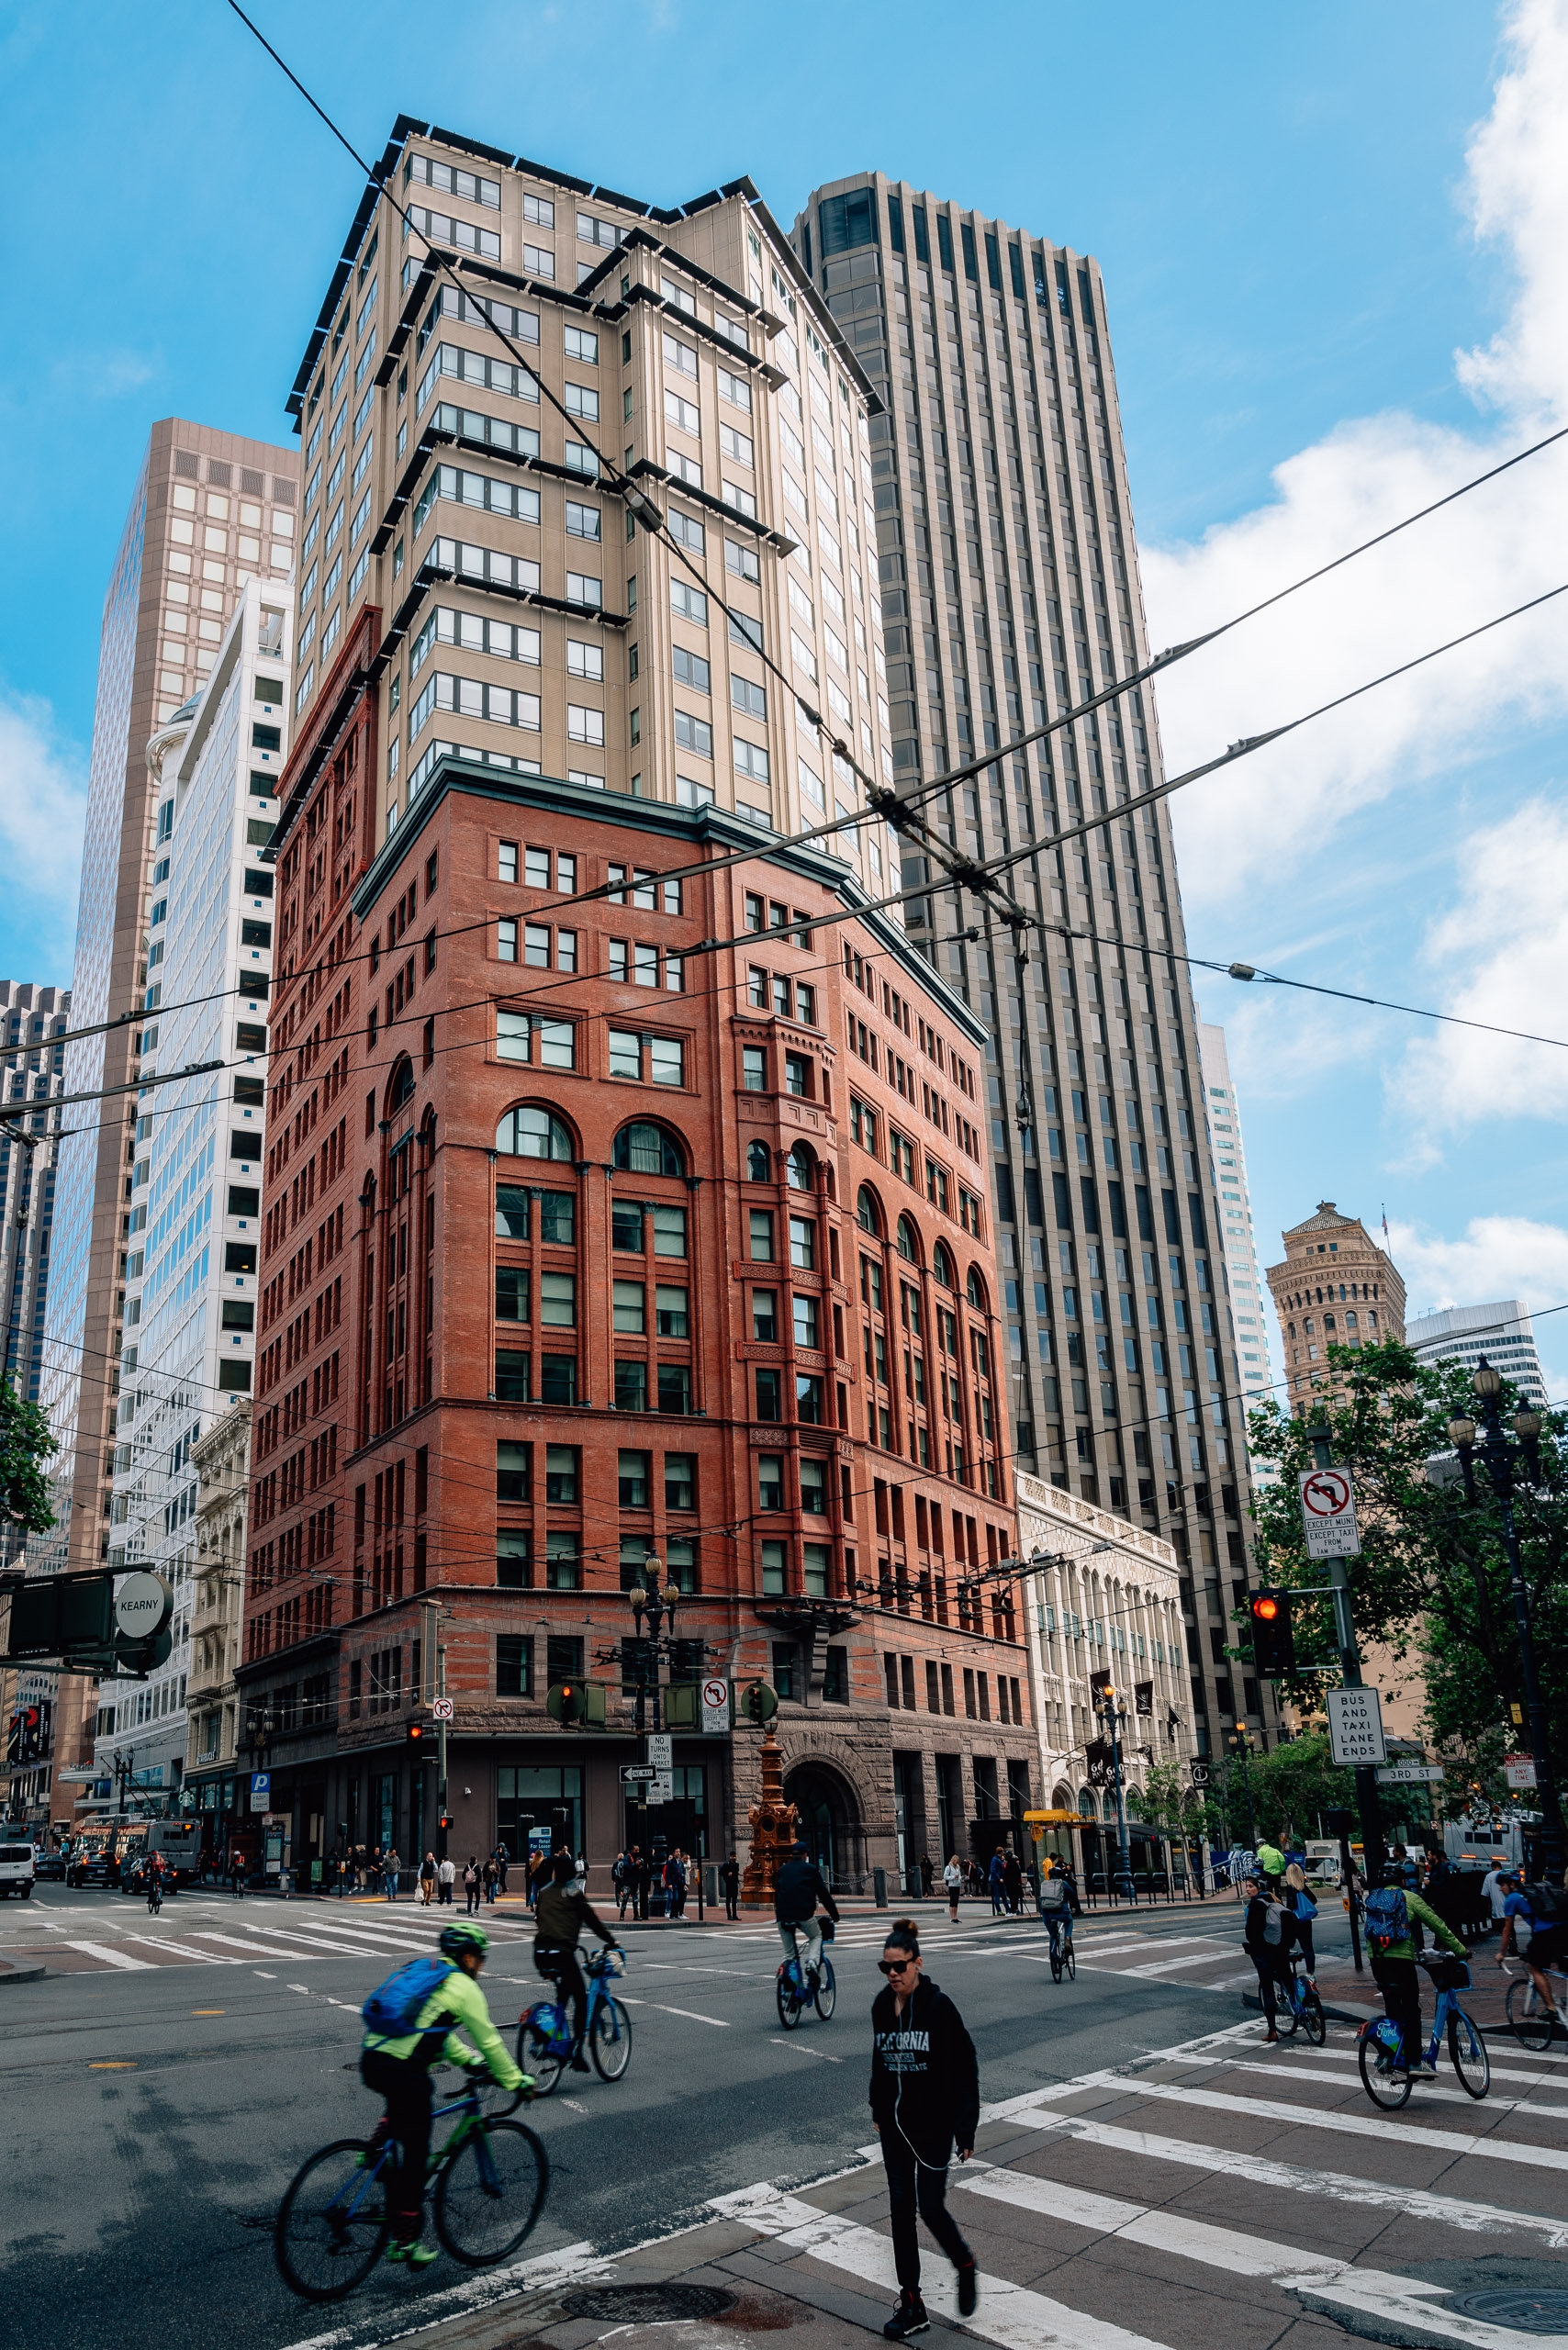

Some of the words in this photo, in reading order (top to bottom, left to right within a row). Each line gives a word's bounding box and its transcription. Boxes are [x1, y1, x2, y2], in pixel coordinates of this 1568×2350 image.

[1307, 1519, 1332, 1528] EXCEPT
[1336, 1517, 1353, 1526] MUNI
[1310, 1530, 1335, 1539] EXCEPT
[120, 1599, 159, 1611] KEARNY
[1341, 1696, 1365, 1705] BUS
[1342, 1709, 1367, 1718] AND
[812, 1721, 852, 1729] BUILDING
[1342, 1721, 1371, 1729] TAXI
[1341, 1734, 1374, 1742] LANE
[1343, 1747, 1375, 1755] ENDS
[1391, 1771, 1411, 1779] 3RD
[1377, 2022, 1397, 2037] Ford
